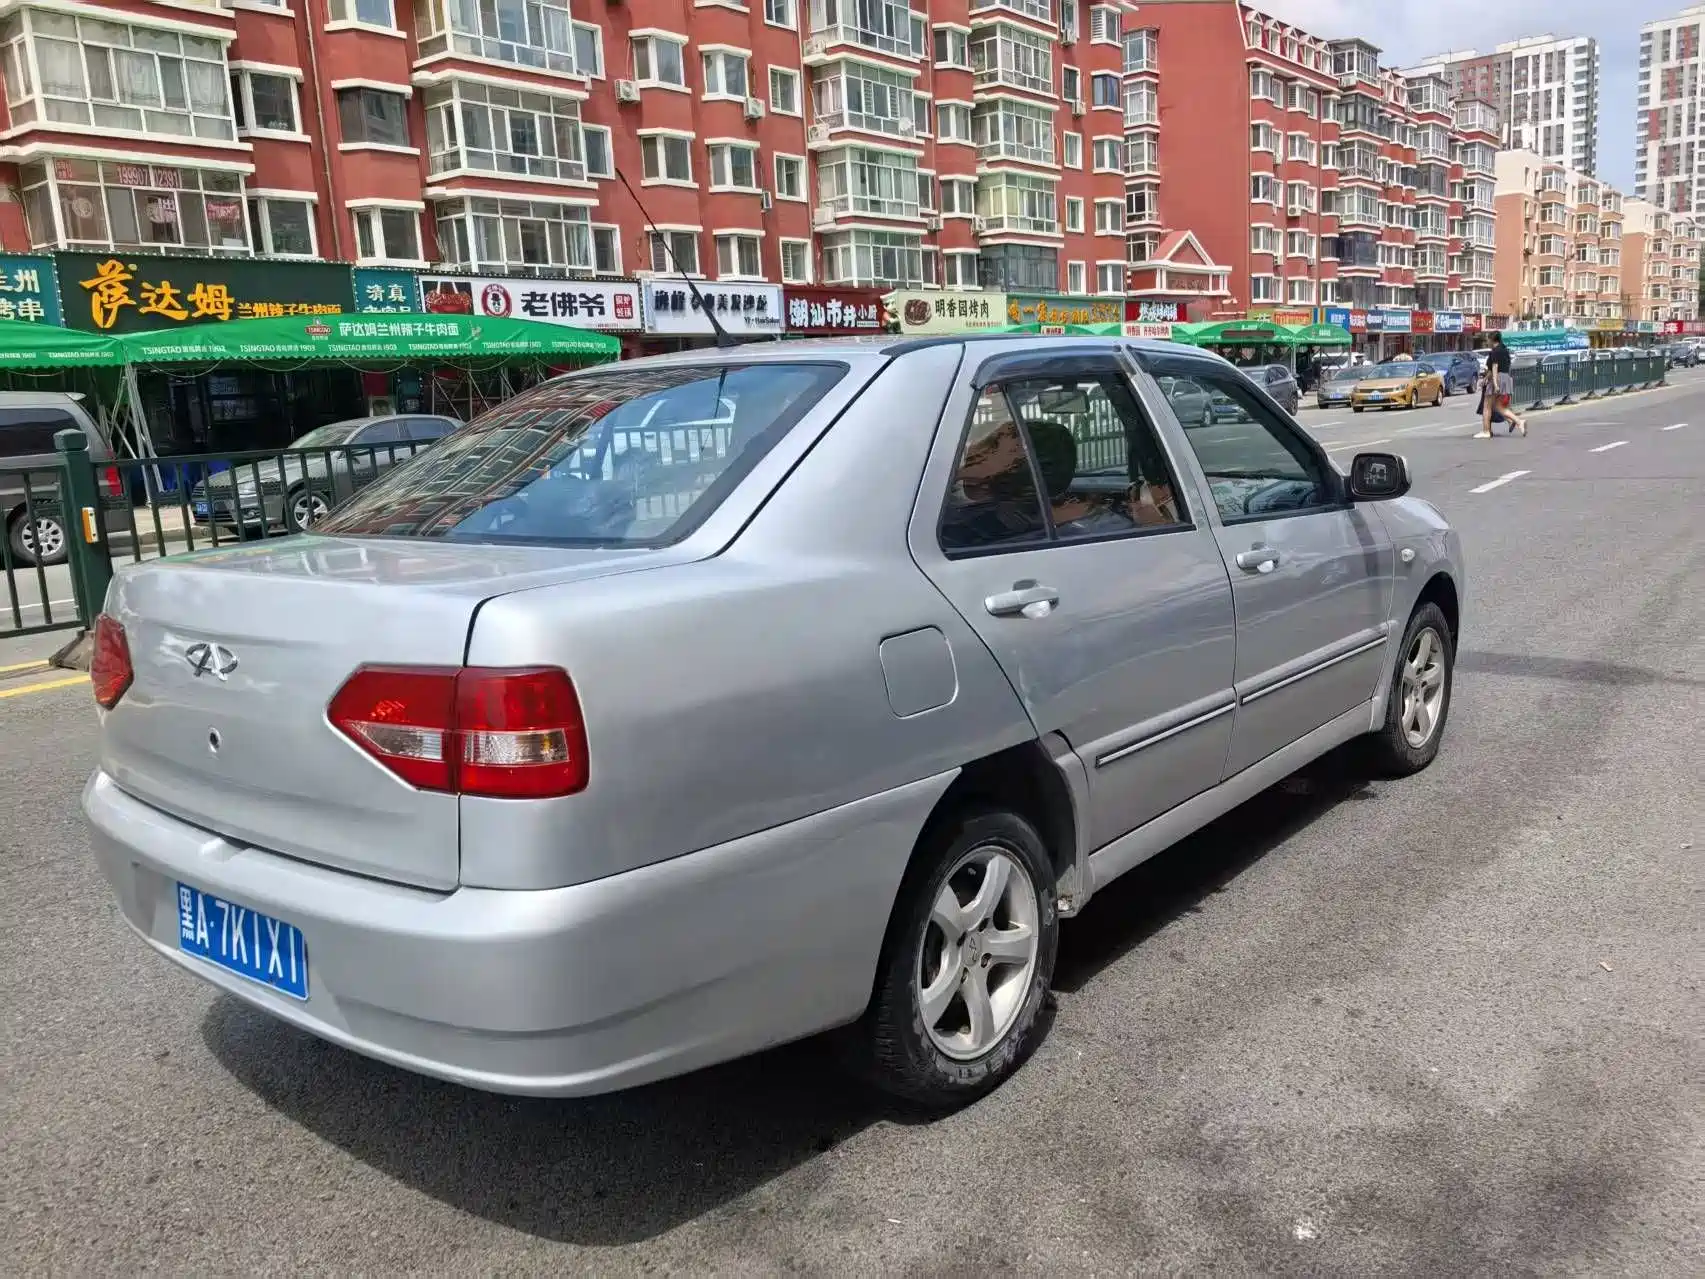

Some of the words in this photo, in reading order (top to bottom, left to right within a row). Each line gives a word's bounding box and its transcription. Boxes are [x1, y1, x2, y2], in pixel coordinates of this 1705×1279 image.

[79, 258, 235, 329] 萨达姆
[365, 283, 407, 302] 清真
[520, 291, 605, 317] 老佛爷
[934, 298, 989, 319] 明香园烤肉
[143, 345, 182, 356] TSINGTAO
[239, 344, 276, 353] TSINGTAO
[299, 343, 316, 352] 1903
[327, 343, 361, 353] TSINGTAO
